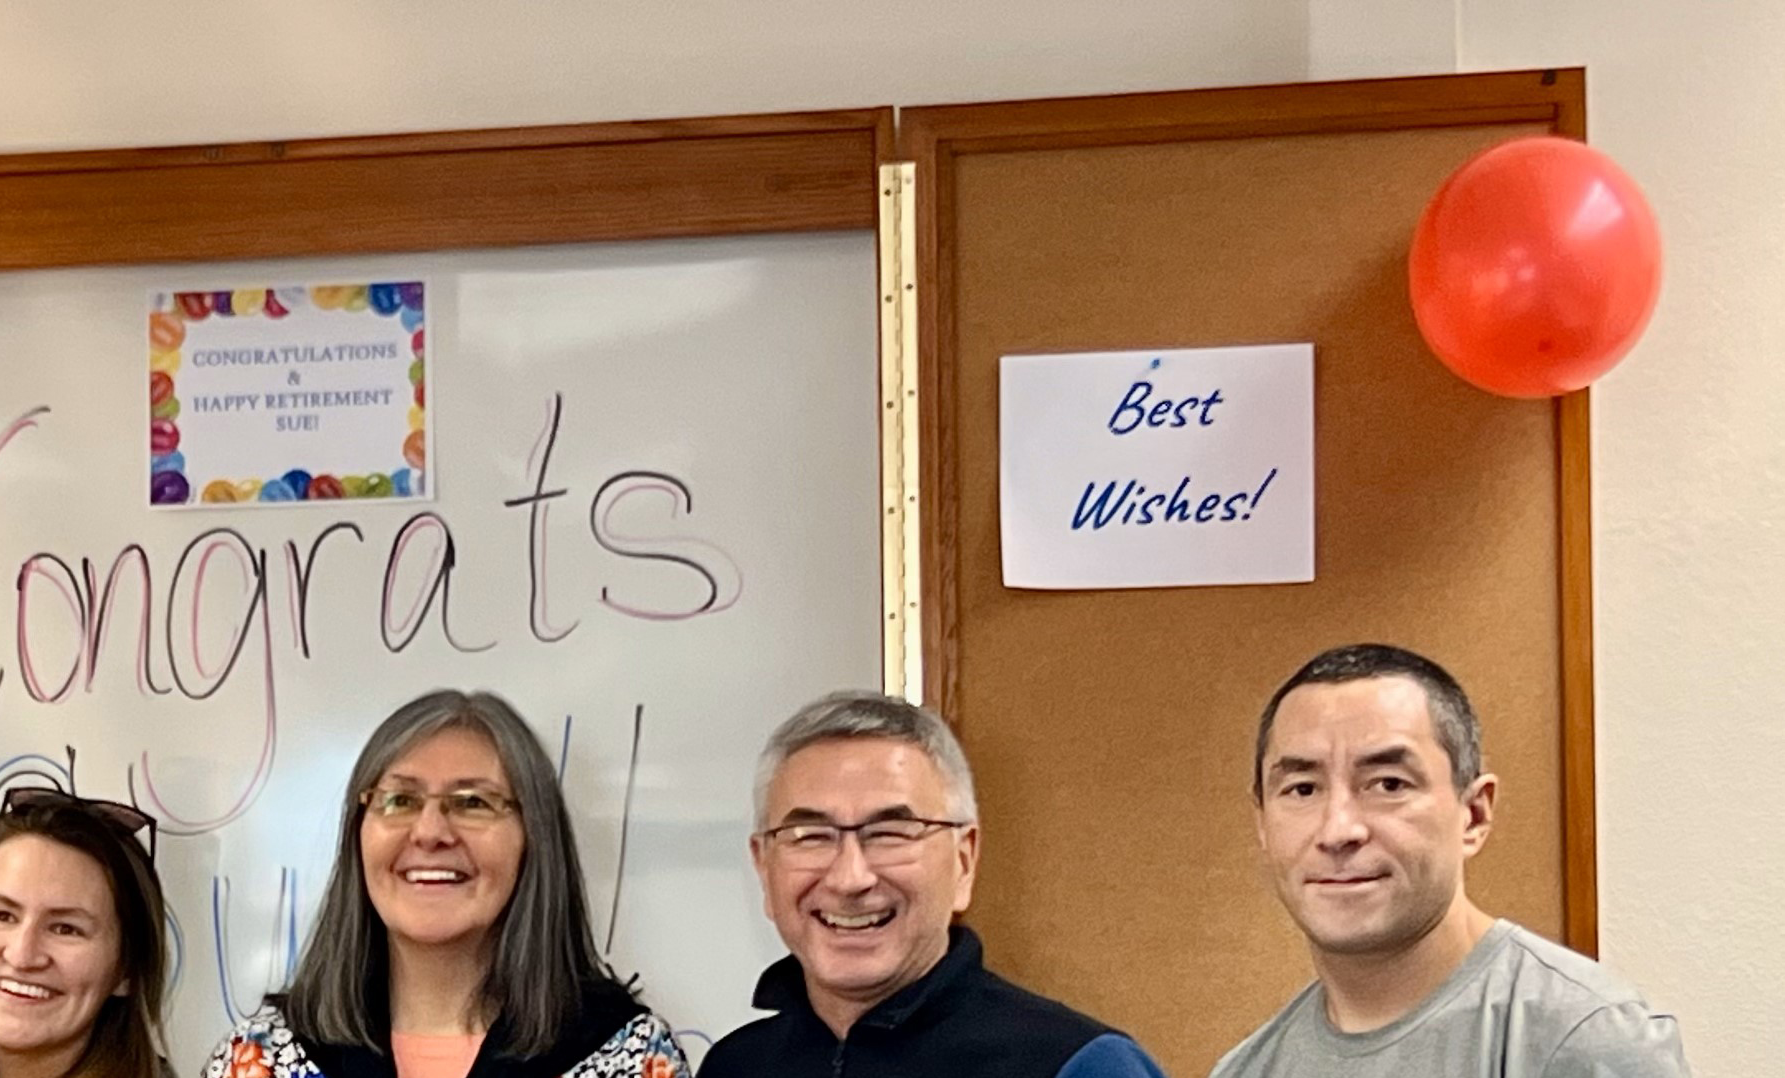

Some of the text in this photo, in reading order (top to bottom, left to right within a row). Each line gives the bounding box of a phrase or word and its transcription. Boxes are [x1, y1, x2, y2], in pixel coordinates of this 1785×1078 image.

[192, 343, 398, 368] CONGRATULATIONS
[286, 369, 302, 386] &
[193, 389, 394, 413] HAPPY RETIREMENT
[1108, 381, 1224, 435] Best
[275, 414, 320, 432] SUE!
[1070, 467, 1278, 530] Wishes!
